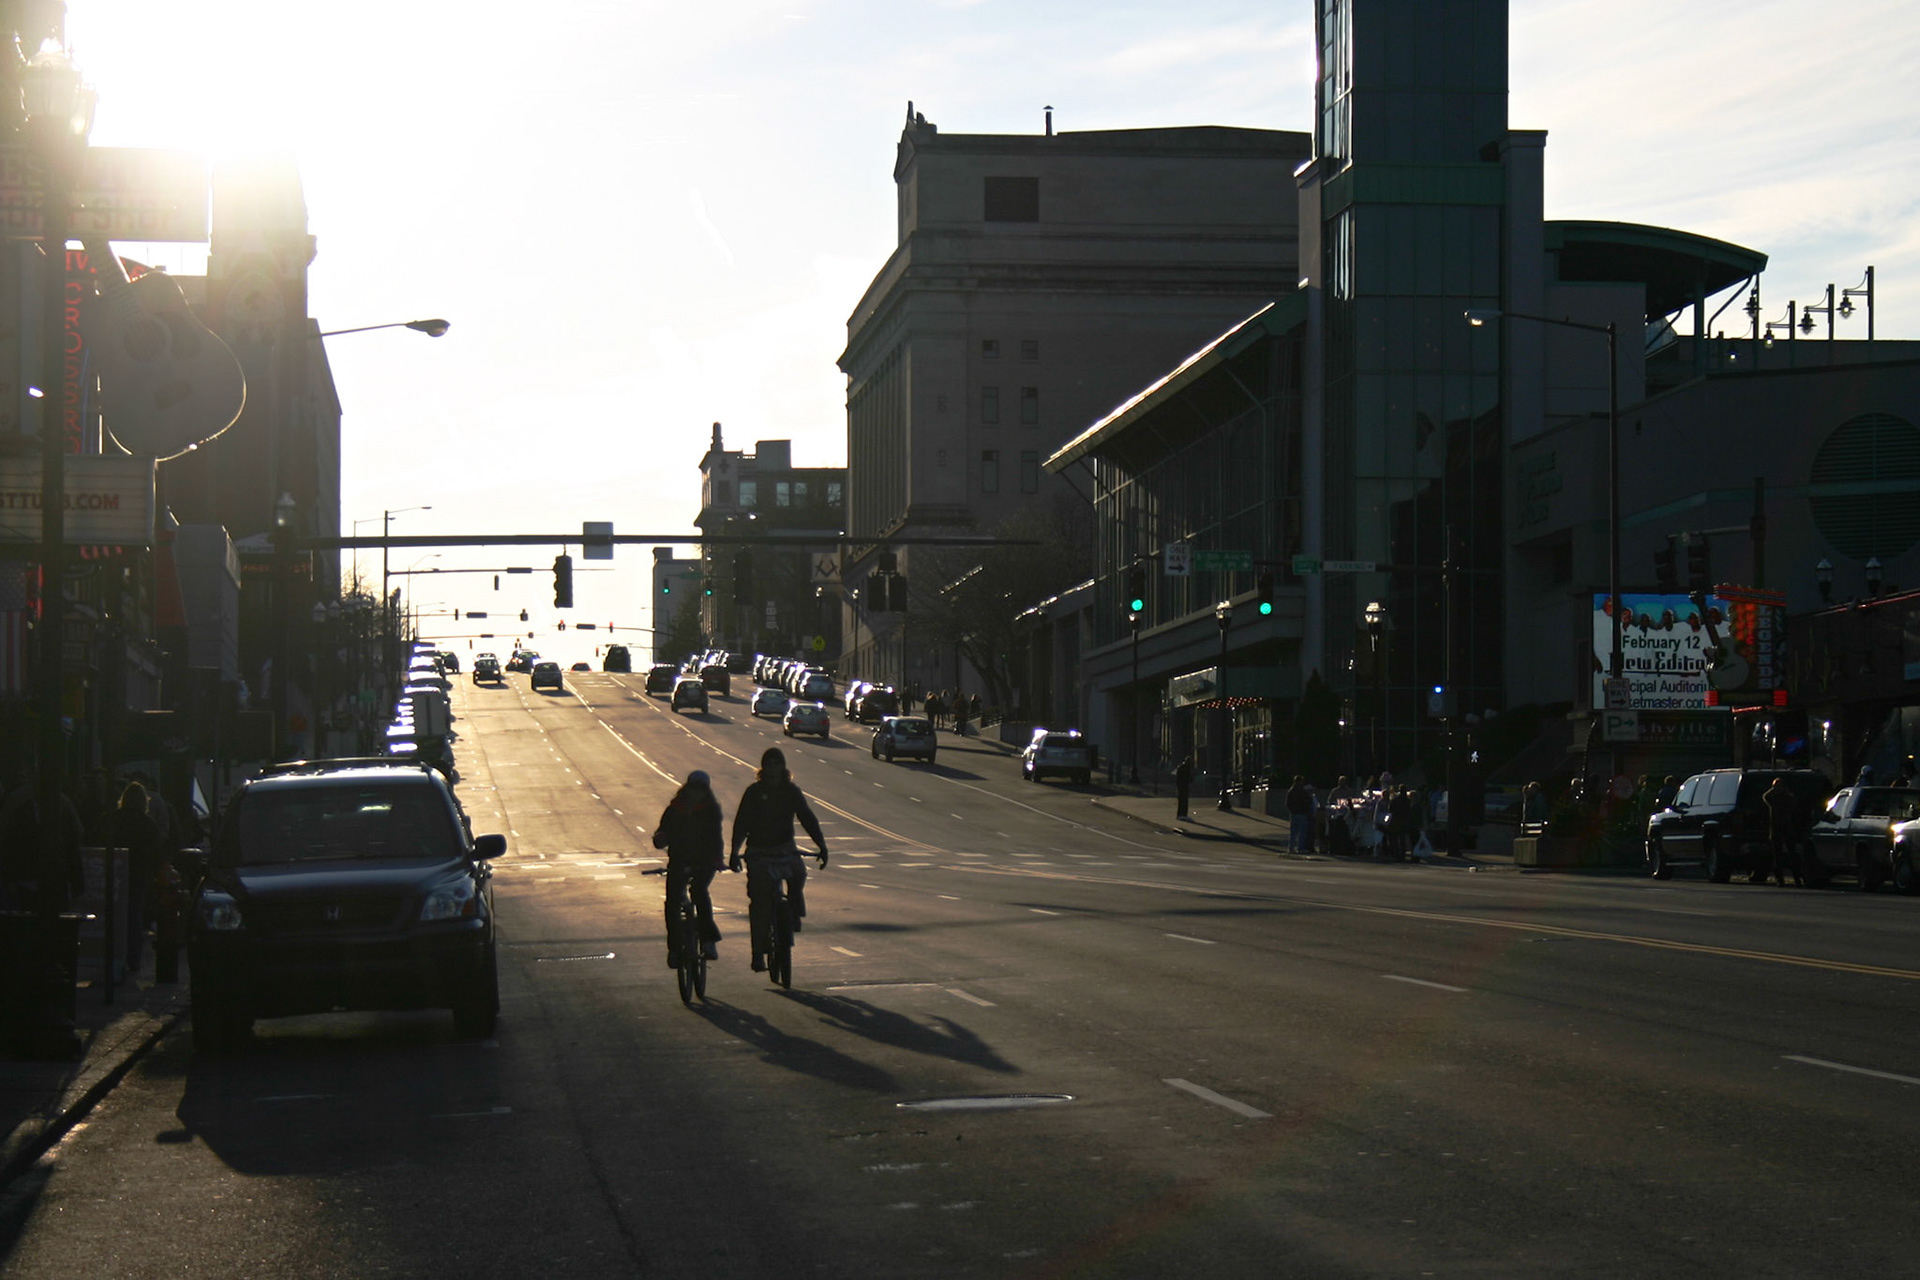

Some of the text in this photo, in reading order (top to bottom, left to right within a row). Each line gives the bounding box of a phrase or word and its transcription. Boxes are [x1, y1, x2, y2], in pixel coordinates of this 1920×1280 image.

[1169, 544, 1186, 553] ONE
[1169, 554, 1187, 562] WAY
[1623, 635, 1701, 652] February 12
[1757, 604, 1774, 690] LEGENDS
[1655, 651, 1705, 676] Editio
[1610, 680, 1627, 688] ONE
[1610, 689, 1627, 697] WAY
[1607, 715, 1622, 736] P
[1638, 721, 1717, 735] shville
